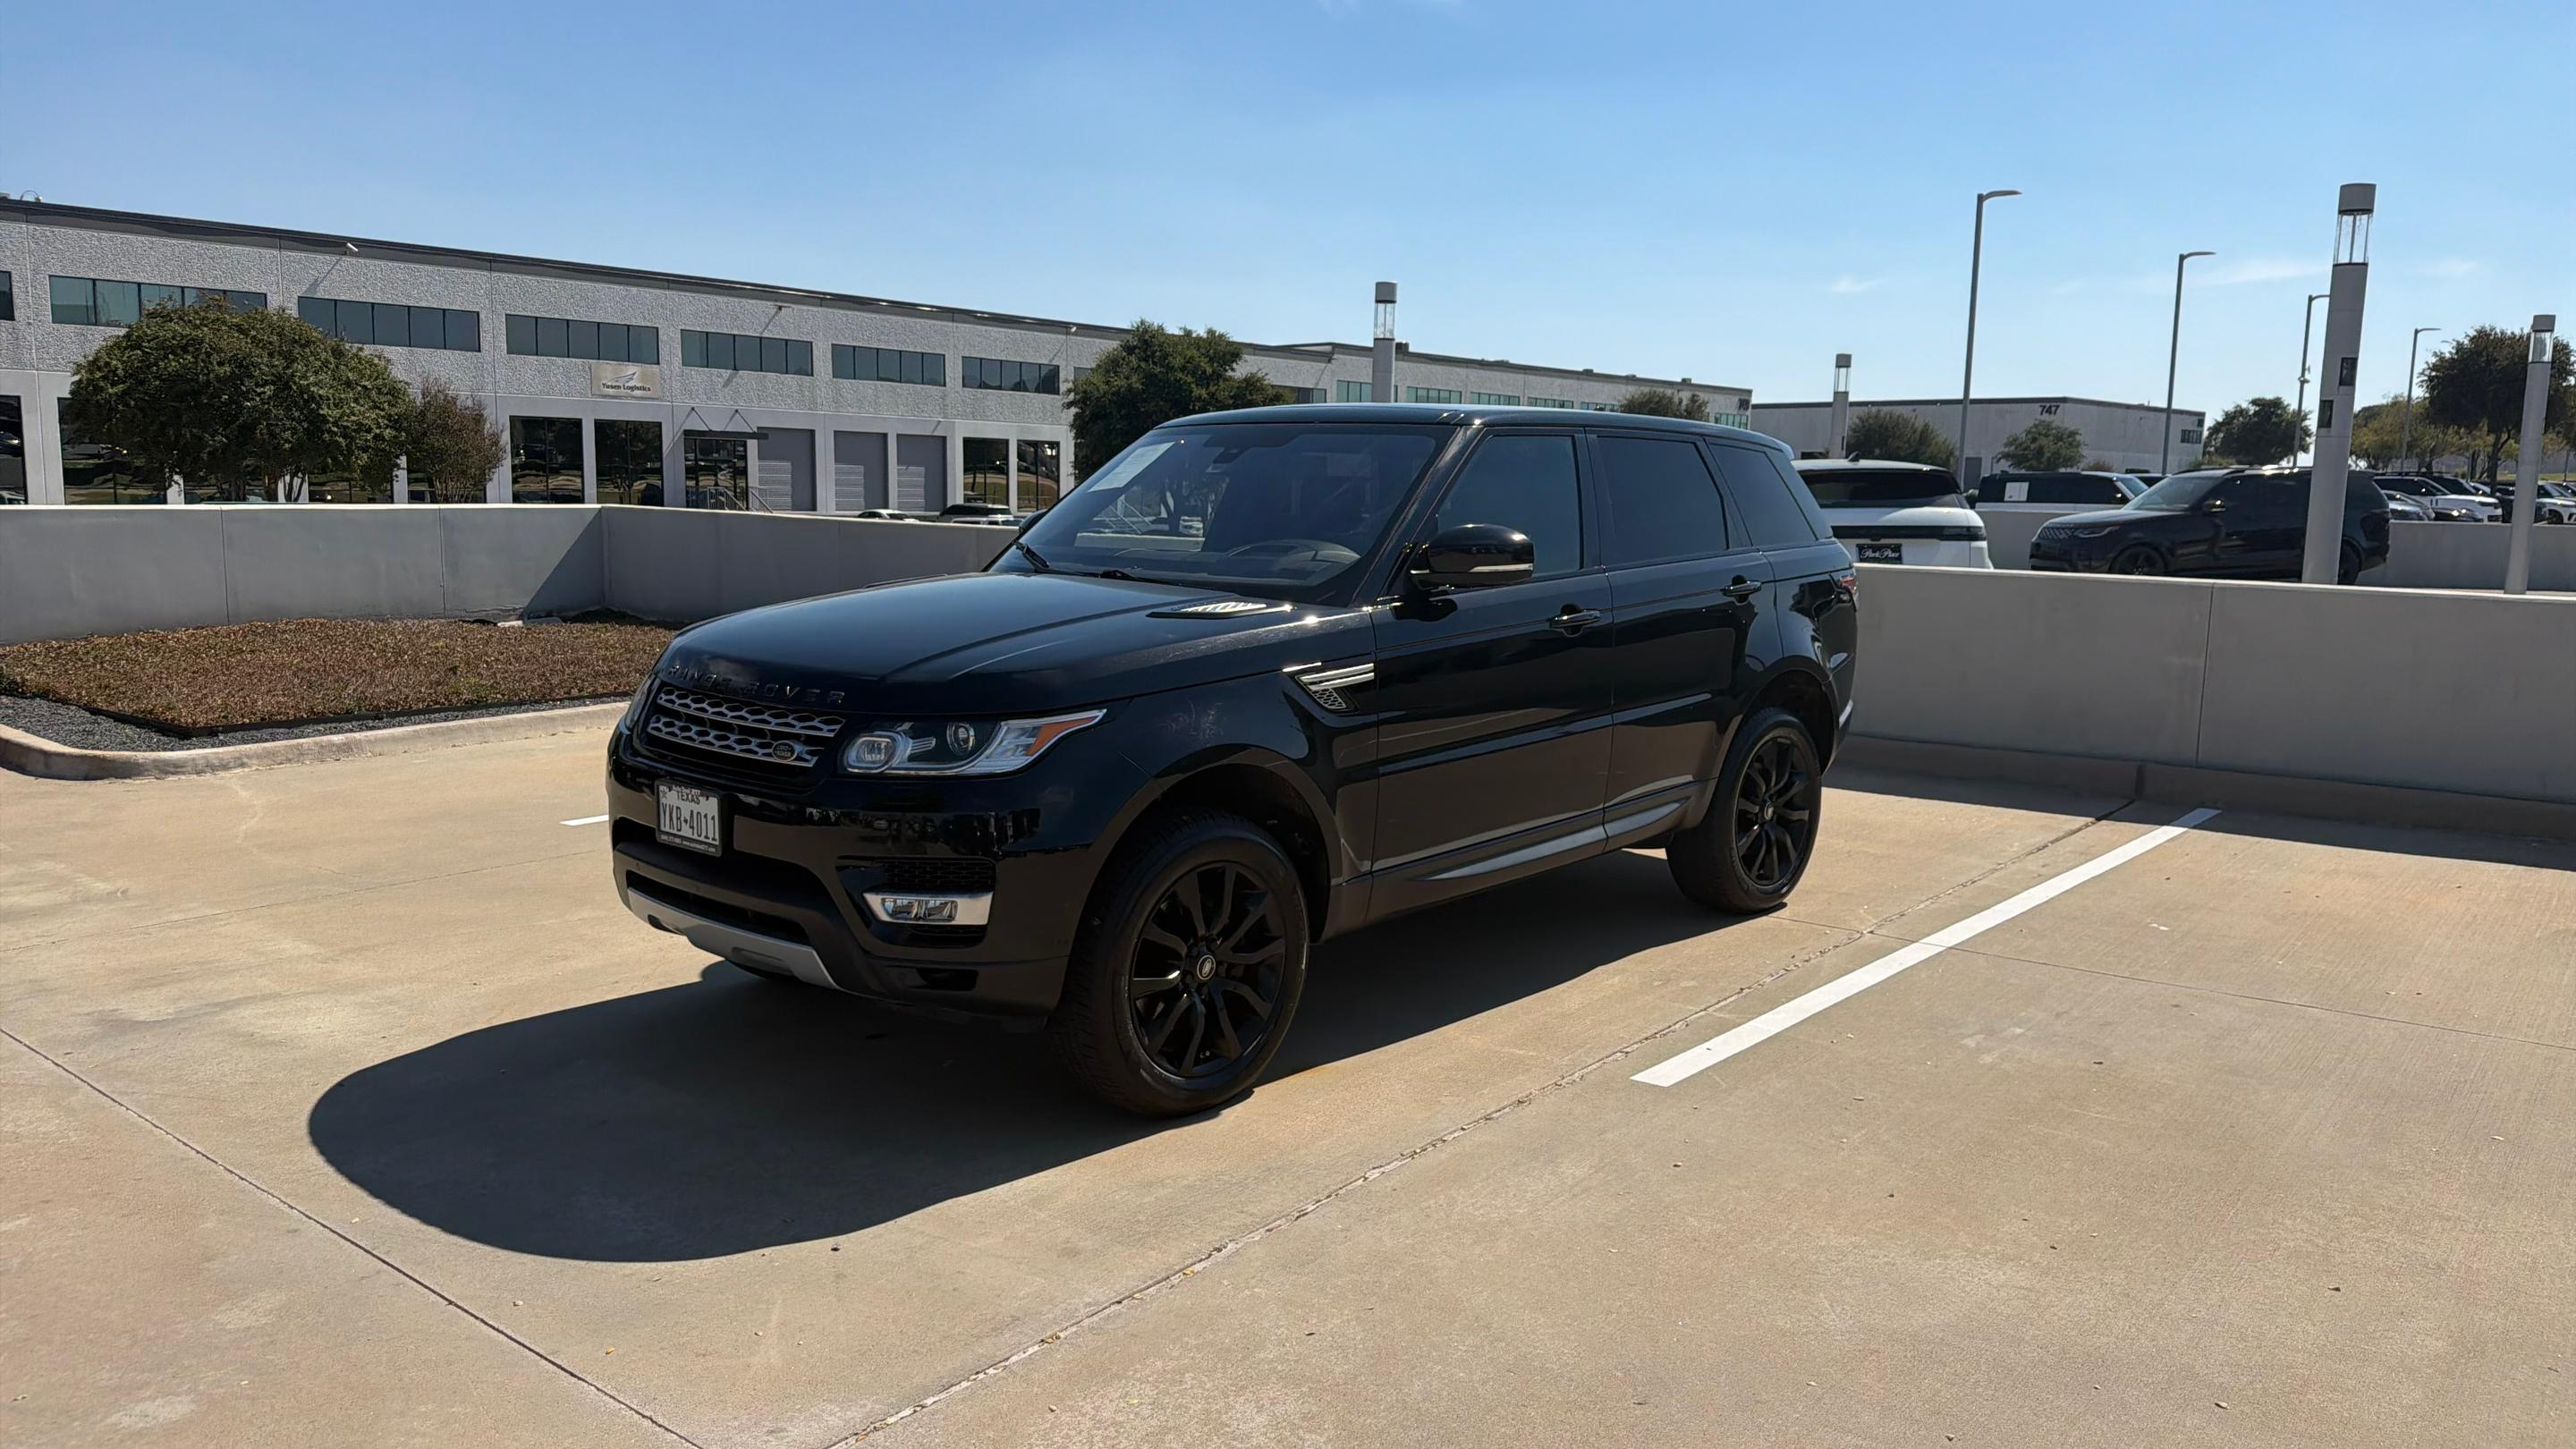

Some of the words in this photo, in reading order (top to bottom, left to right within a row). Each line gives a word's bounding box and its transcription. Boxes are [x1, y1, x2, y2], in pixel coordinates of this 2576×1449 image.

[602, 382, 622, 390] Yusen
[623, 383, 652, 393] Logistics
[2038, 404, 2061, 416] 747
[743, 680, 846, 704] ROVER
[676, 791, 700, 805] TEXAS
